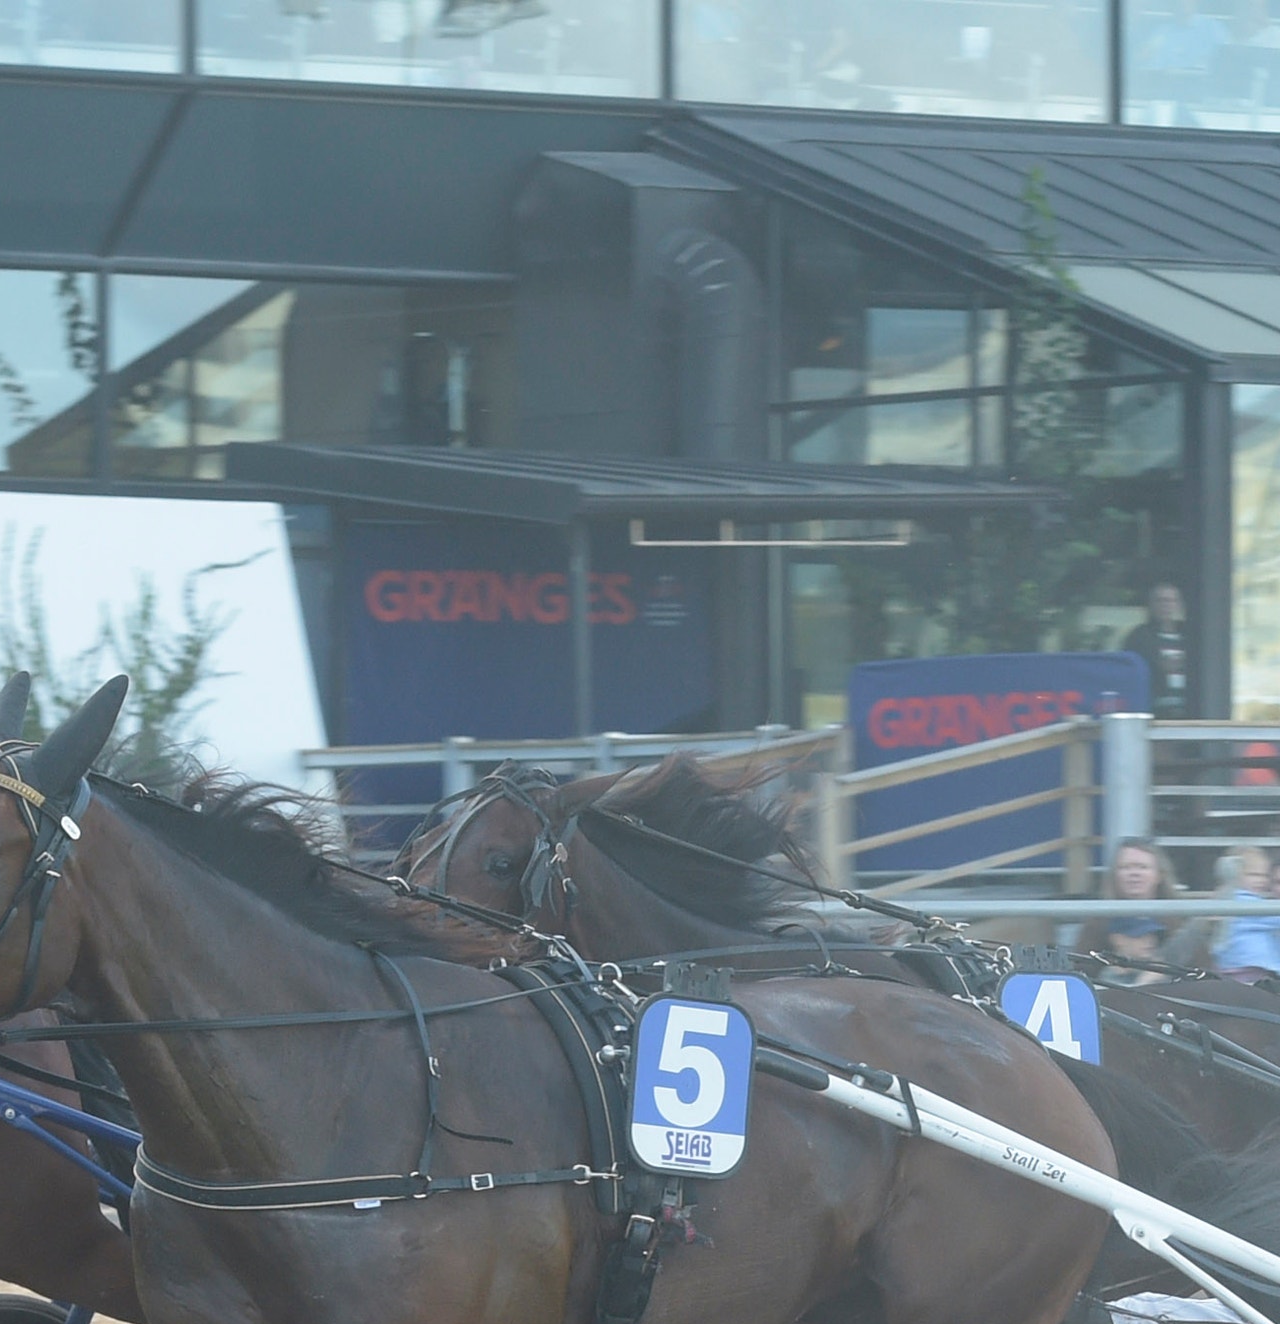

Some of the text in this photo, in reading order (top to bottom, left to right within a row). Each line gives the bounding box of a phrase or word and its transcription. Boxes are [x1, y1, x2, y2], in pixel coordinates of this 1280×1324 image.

[1025, 980, 1081, 1060] 4
[653, 1005, 729, 1128] 5
[661, 1131, 712, 1161] SEIAB
[1002, 1146, 1040, 1172] Stall
